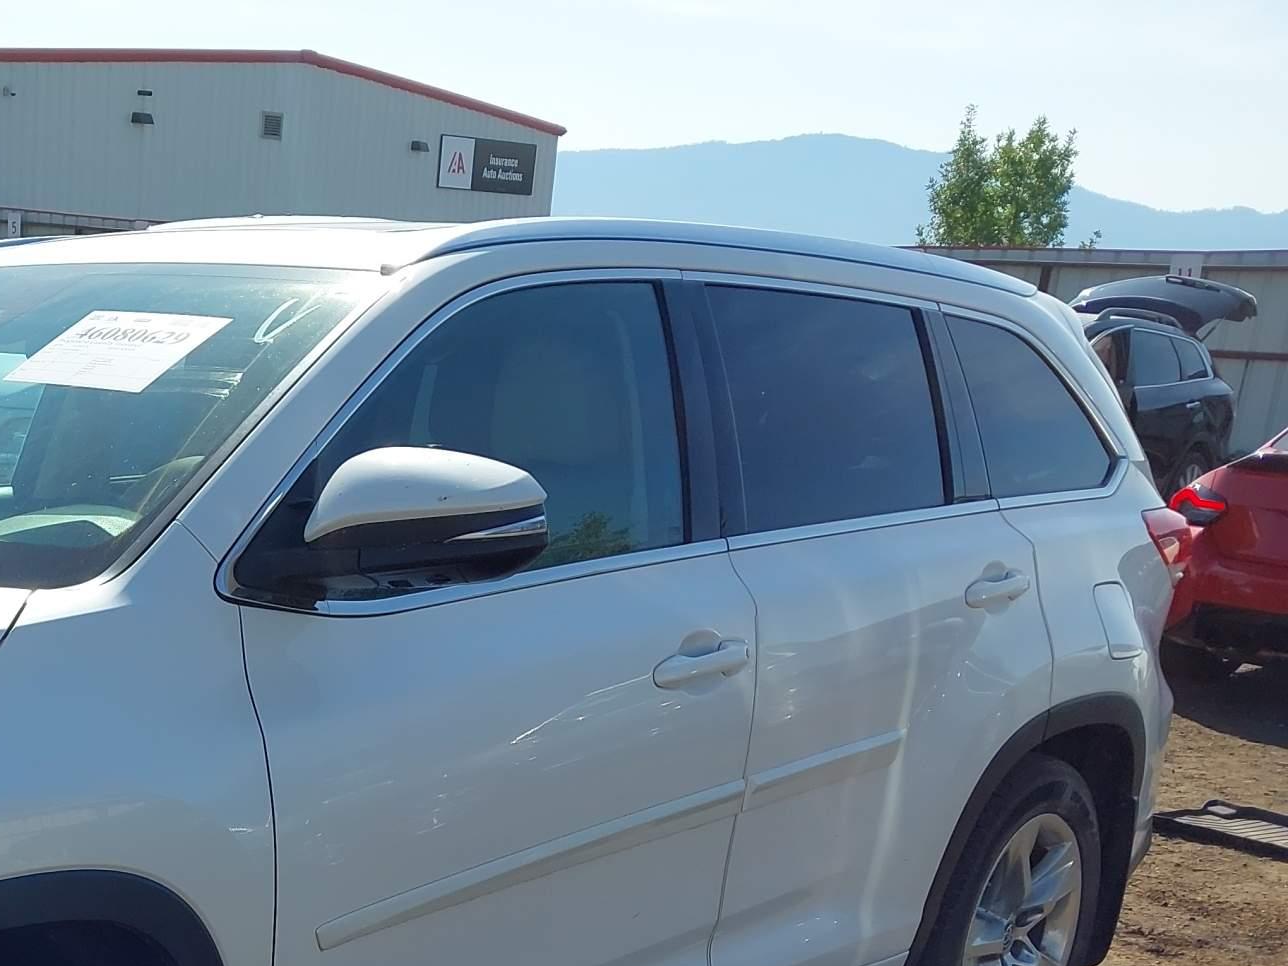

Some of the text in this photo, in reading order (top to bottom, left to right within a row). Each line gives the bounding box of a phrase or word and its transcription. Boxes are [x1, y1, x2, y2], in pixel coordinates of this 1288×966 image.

[489, 153, 519, 168] Insurance
[482, 167, 523, 181] Auto Auctions
[11, 221, 17, 234] 5
[75, 325, 191, 345] 46080629
